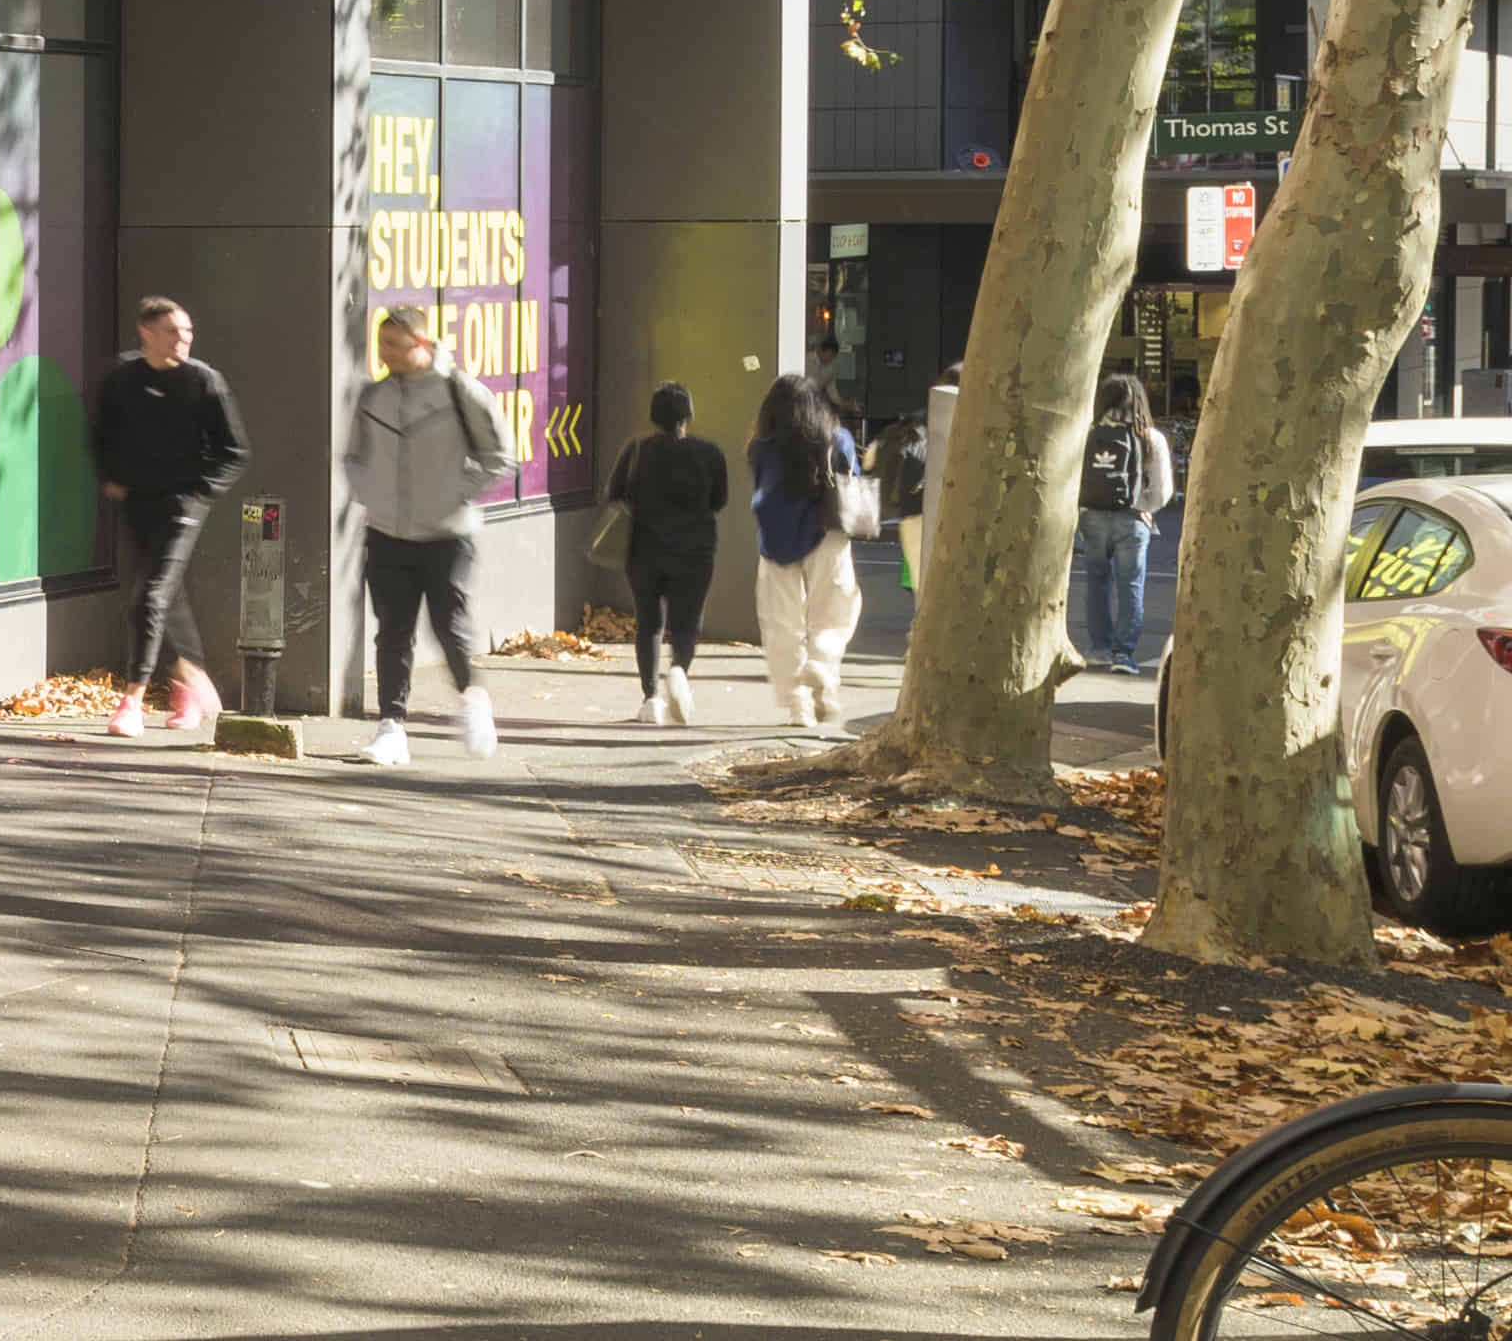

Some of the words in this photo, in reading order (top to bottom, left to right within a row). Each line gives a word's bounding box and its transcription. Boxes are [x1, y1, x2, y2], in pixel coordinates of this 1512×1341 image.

[370, 113, 441, 211] HEY,
[1163, 117, 1257, 138] Thomas
[1264, 115, 1289, 136] St
[1231, 190, 1246, 205] NO
[368, 209, 526, 291] STUDENTS
[463, 302, 505, 379] ON
[509, 300, 538, 375] IN
